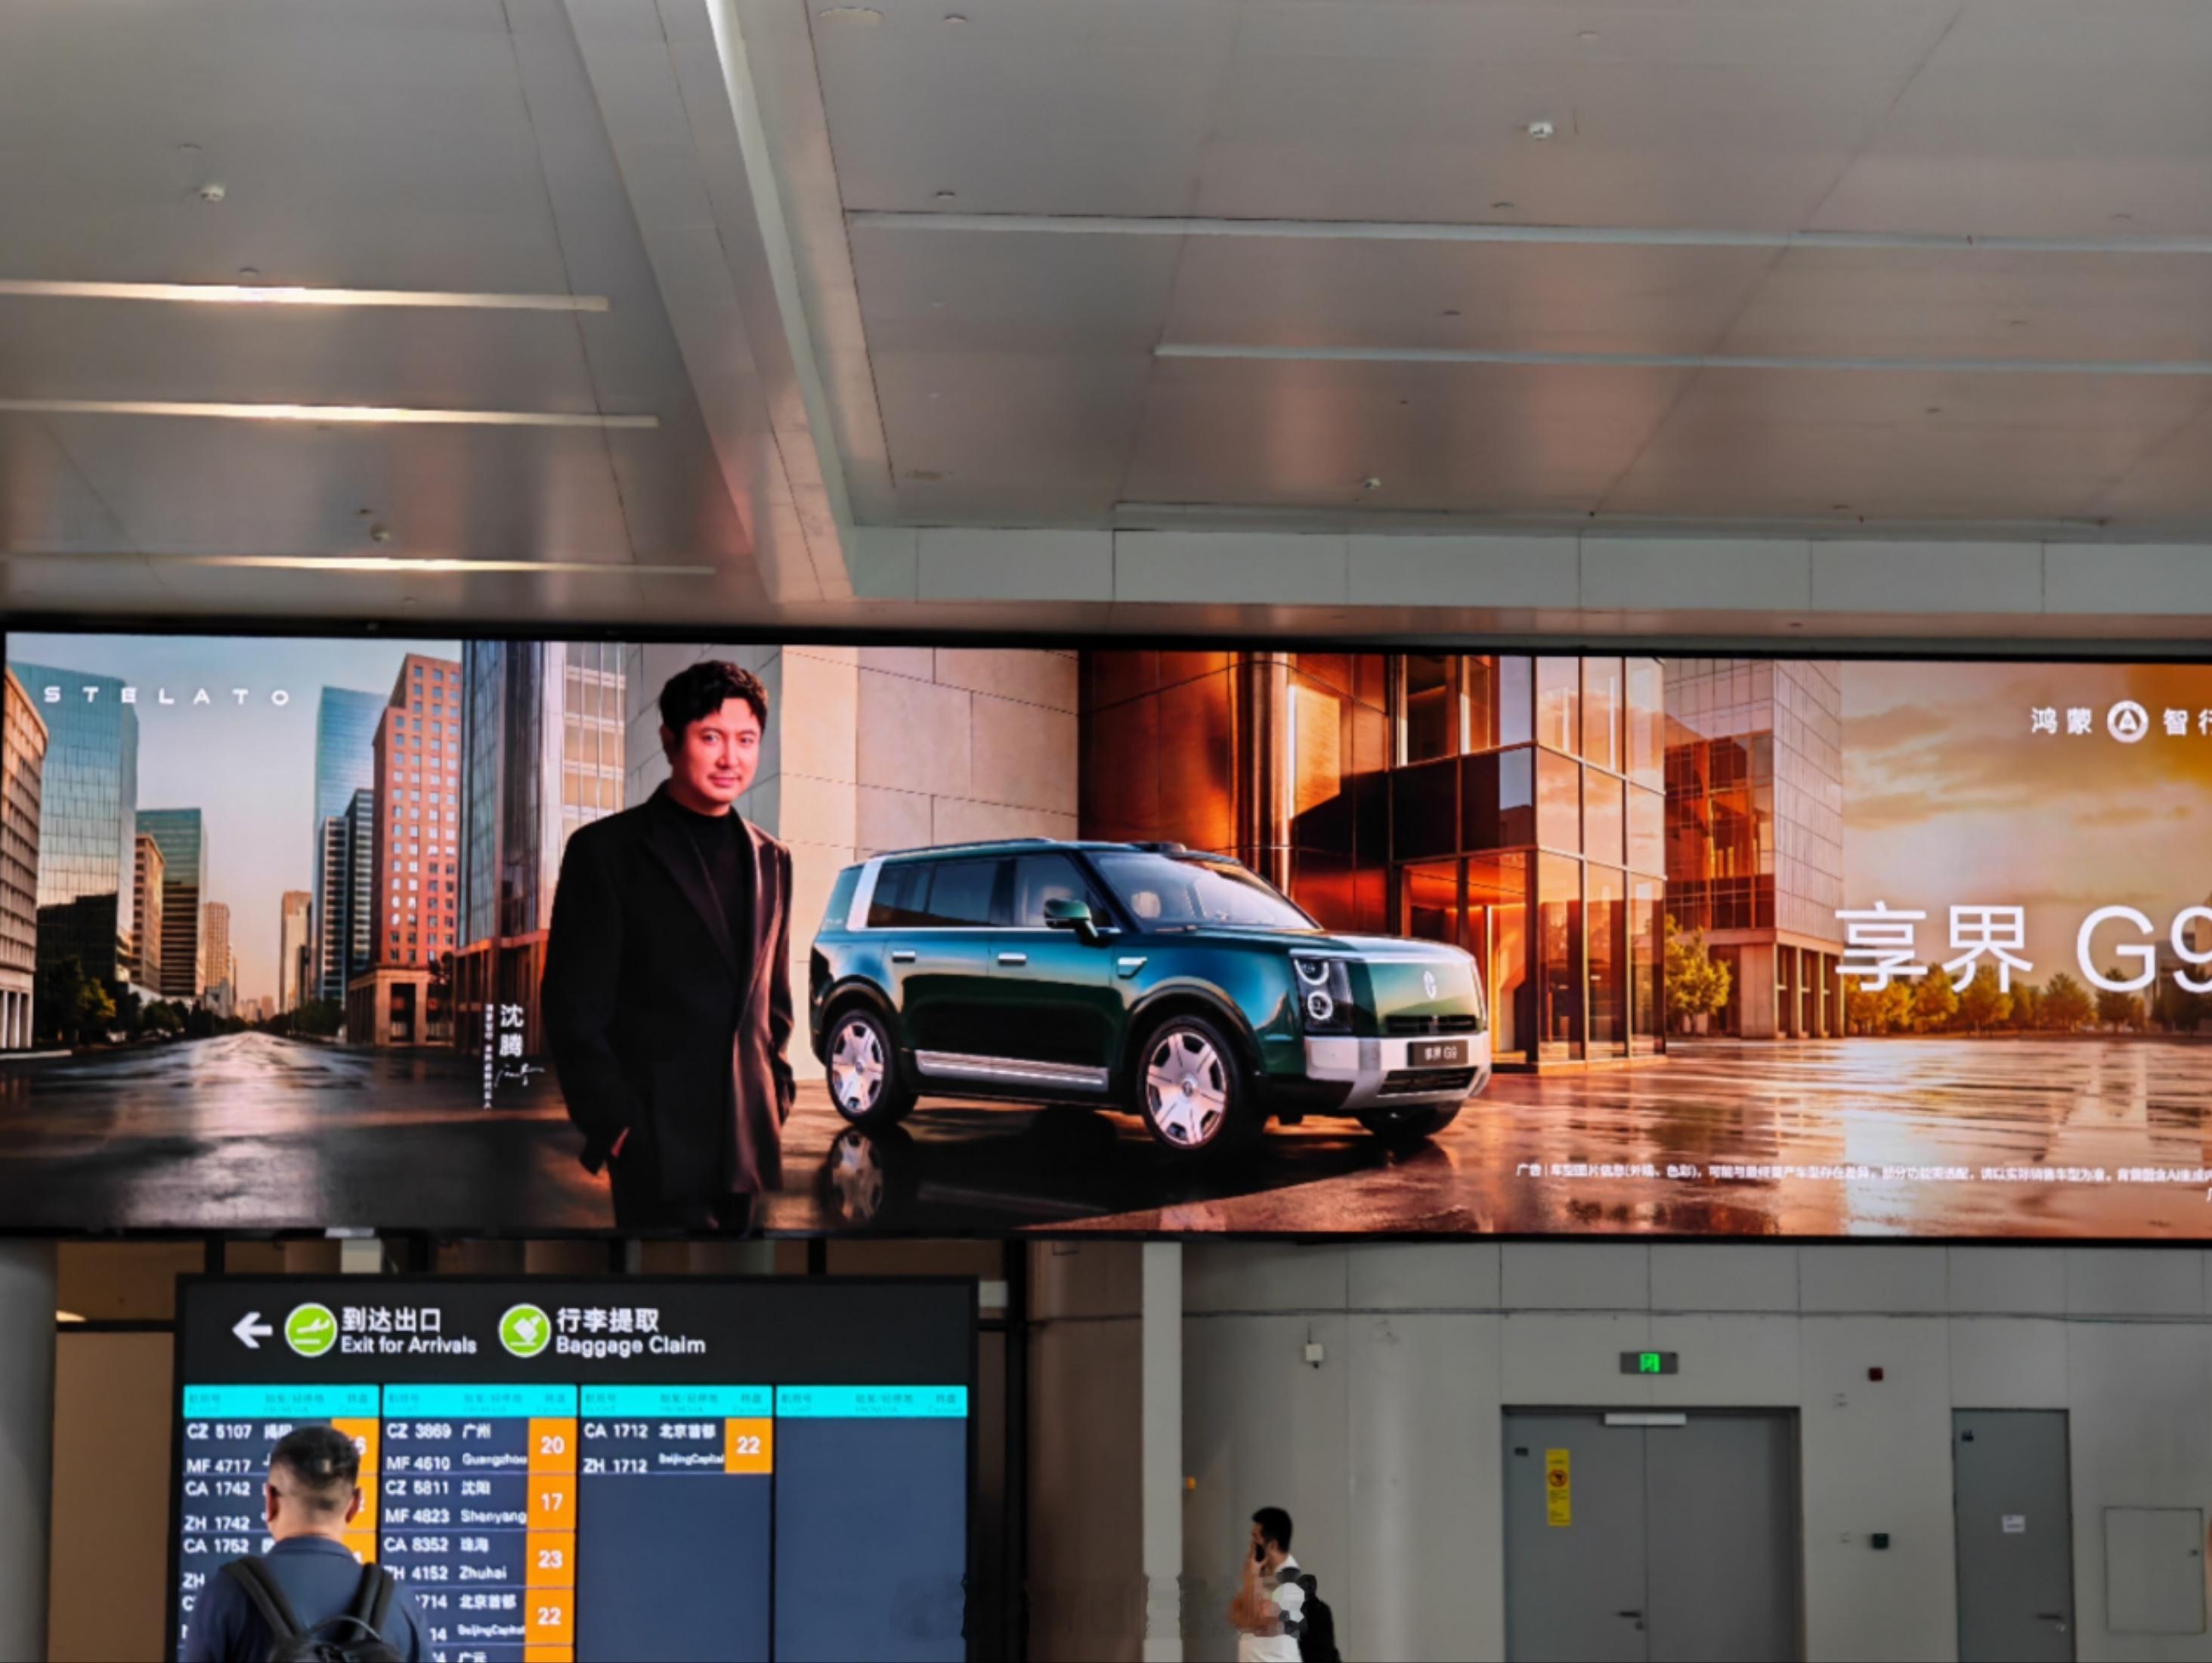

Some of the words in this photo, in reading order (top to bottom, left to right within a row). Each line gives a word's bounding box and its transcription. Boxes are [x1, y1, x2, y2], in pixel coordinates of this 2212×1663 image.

[44, 686, 289, 706] STELATO
[2031, 708, 2092, 735] 鸿蒙
[1835, 901, 2033, 993] 享界
[2077, 906, 2212, 993] G9
[500, 1003, 524, 1058] 沈腾
[342, 1306, 441, 1333] 到达出口
[556, 1307, 659, 1333] 行李提取
[342, 1336, 374, 1353] Exit
[379, 1336, 404, 1353] for
[409, 1336, 478, 1354] Arrivals
[556, 1335, 643, 1358] Baggage
[649, 1334, 706, 1354] Claim
[187, 1423, 209, 1439] CZ
[387, 1423, 409, 1439] CZ
[463, 1423, 492, 1439] 广州
[583, 1423, 608, 1438] CA
[614, 1423, 649, 1438] 1712
[659, 1423, 716, 1439] 北京首都
[540, 1436, 565, 1454] 20
[736, 1436, 761, 1454] 22
[187, 1459, 211, 1473] MF
[215, 1459, 252, 1473] 4717
[386, 1456, 410, 1471] MF
[413, 1456, 451, 1471] 4610
[463, 1453, 527, 1468] Guangzhou
[583, 1458, 605, 1474] ZH
[613, 1460, 648, 1474] 1712
[185, 1481, 209, 1497] CA
[215, 1481, 250, 1497] 1742
[385, 1479, 407, 1496] CZ
[541, 1493, 564, 1511] 17
[184, 1516, 207, 1531] ZH
[215, 1516, 250, 1531] 1742
[385, 1508, 410, 1523] MF
[413, 1508, 450, 1523] 4823
[461, 1508, 527, 1524] Shenyang
[184, 1538, 207, 1553] CA
[214, 1538, 249, 1553] 1752
[384, 1537, 407, 1552] CA
[413, 1537, 449, 1552] 8352
[538, 1550, 563, 1569] 23
[182, 1573, 205, 1588] ZH
[412, 1565, 448, 1581] 4152
[459, 1565, 507, 1581] Zhuhai
[415, 1594, 447, 1609] 714
[538, 1608, 562, 1625] 22
